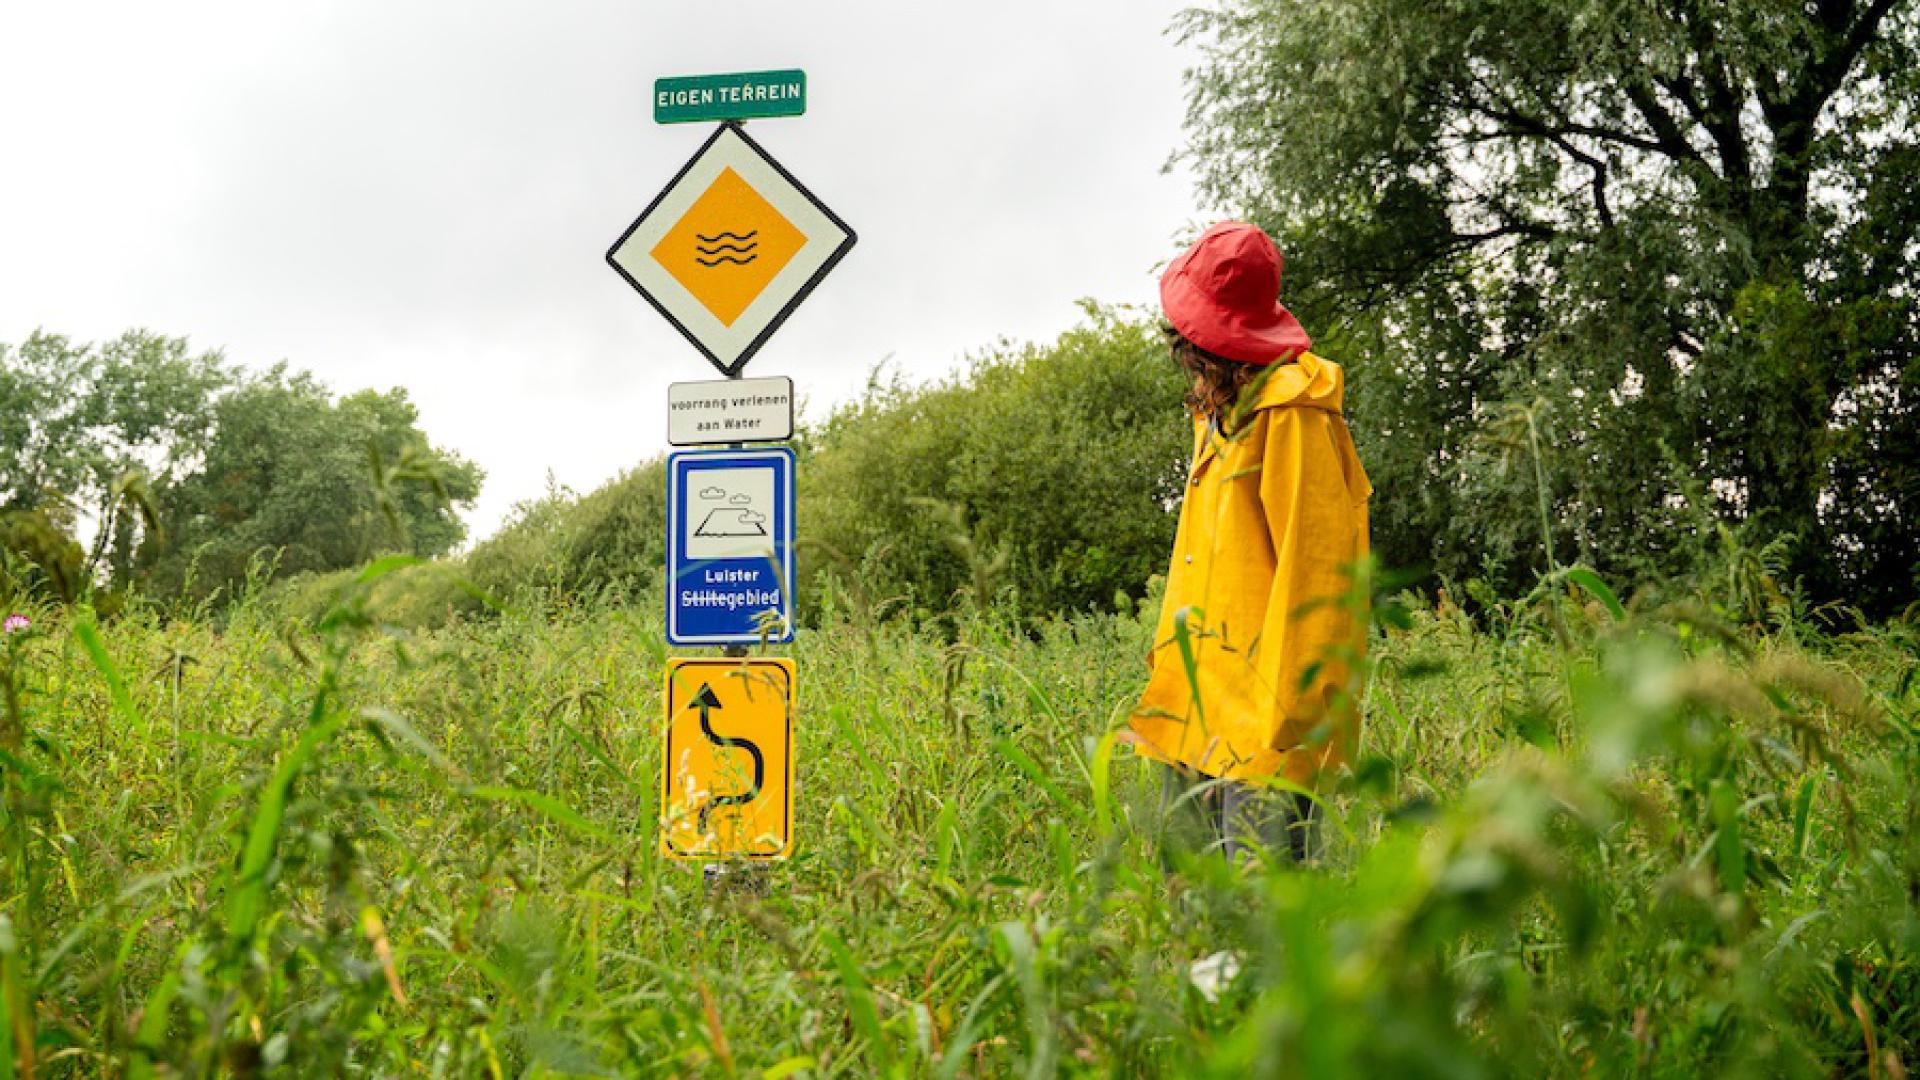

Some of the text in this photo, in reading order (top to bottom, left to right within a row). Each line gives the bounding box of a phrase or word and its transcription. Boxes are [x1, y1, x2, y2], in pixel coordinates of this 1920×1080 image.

[658, 83, 800, 107] EIGEN TERREIN
[672, 395, 788, 412] voorrang verlenen
[697, 418, 761, 431] aan Water
[705, 569, 760, 583] Luister
